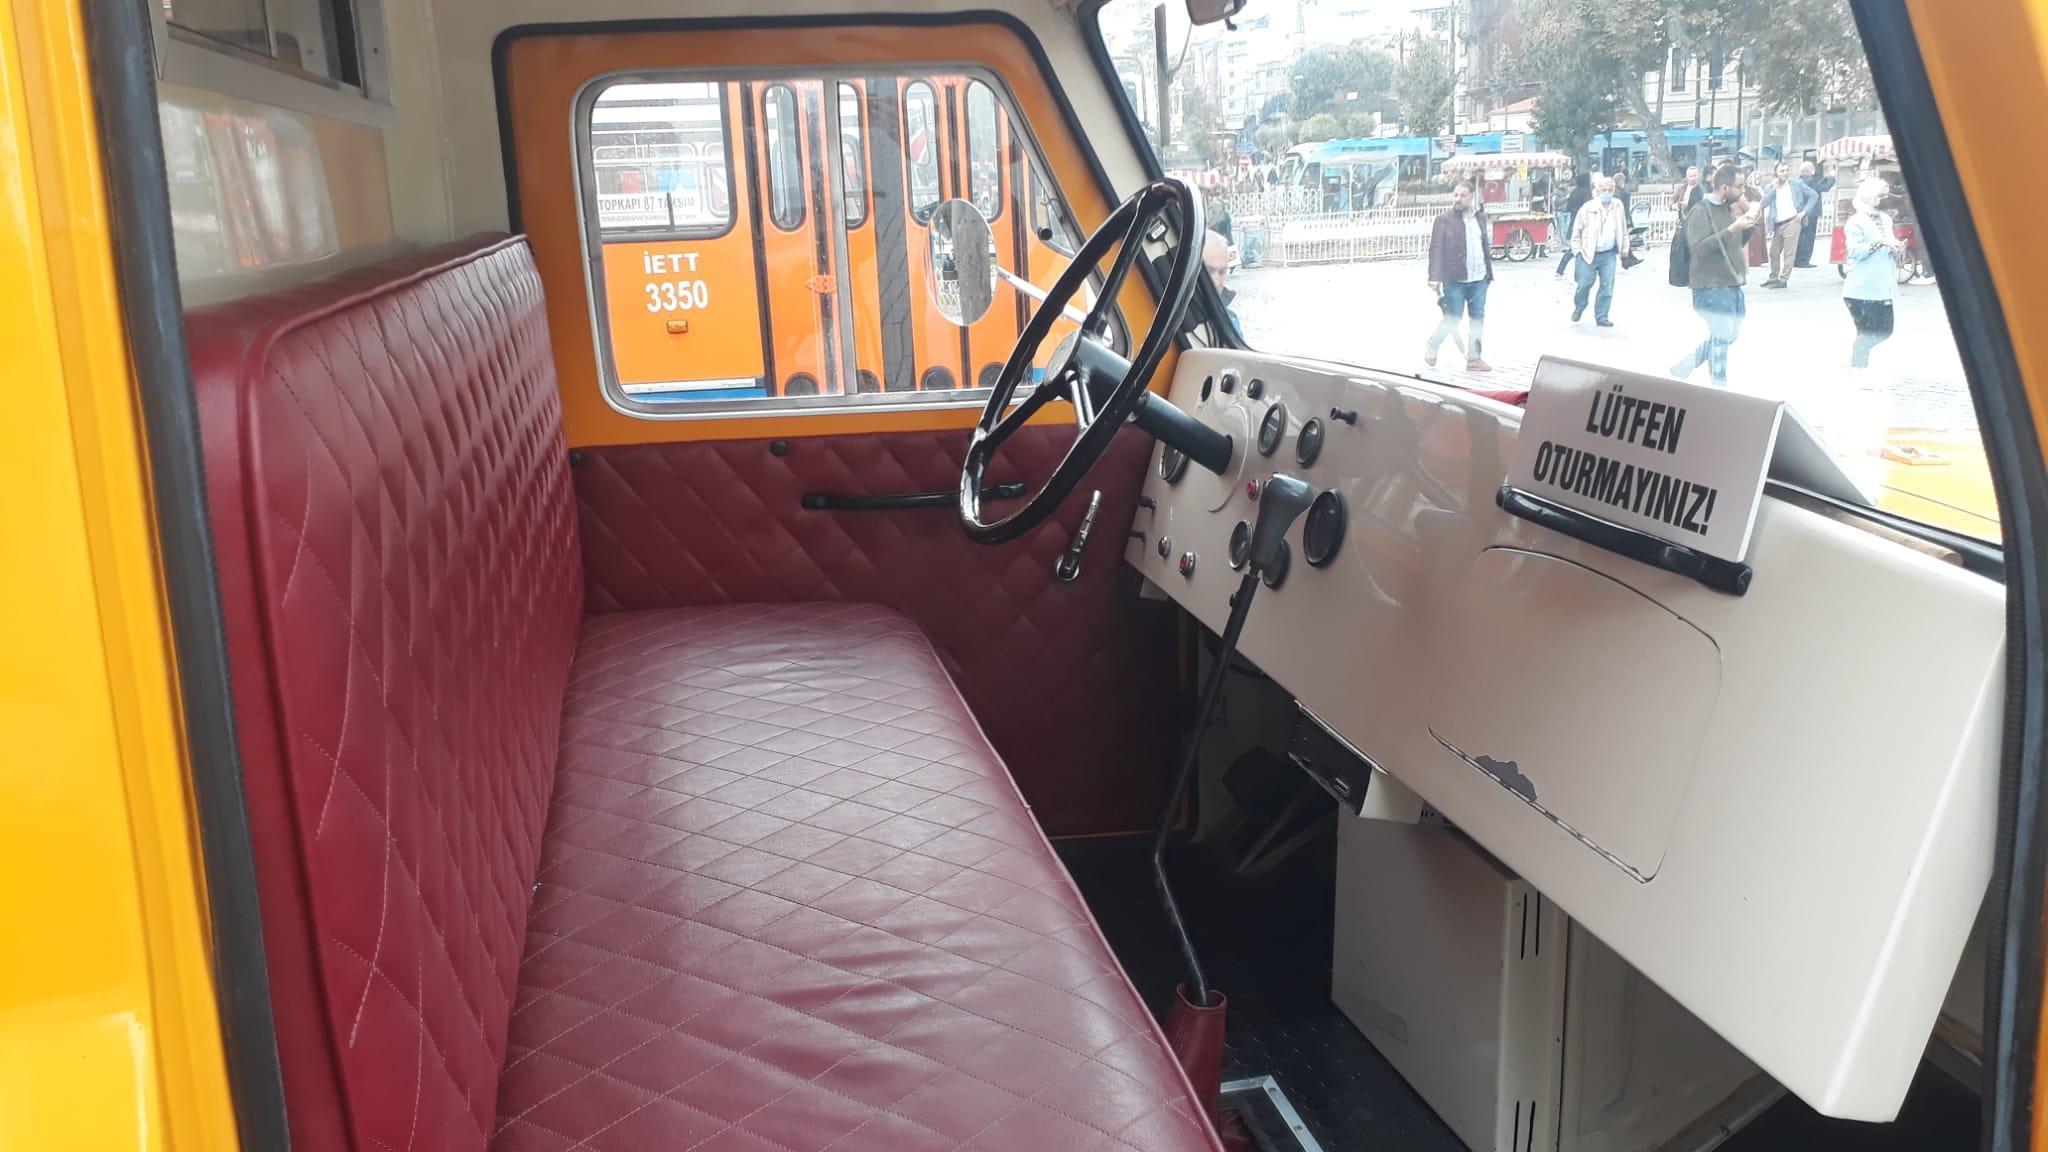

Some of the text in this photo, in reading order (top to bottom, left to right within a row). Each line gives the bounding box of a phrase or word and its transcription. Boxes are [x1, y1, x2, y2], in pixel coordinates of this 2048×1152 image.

[598, 198, 641, 211] TOPKAPI
[644, 196, 655, 211] 87
[643, 250, 700, 275] İETT
[645, 279, 709, 313] 3350
[1585, 384, 1687, 455] LÜTFEN
[1532, 440, 1718, 537] OTURMAYINIZ!
